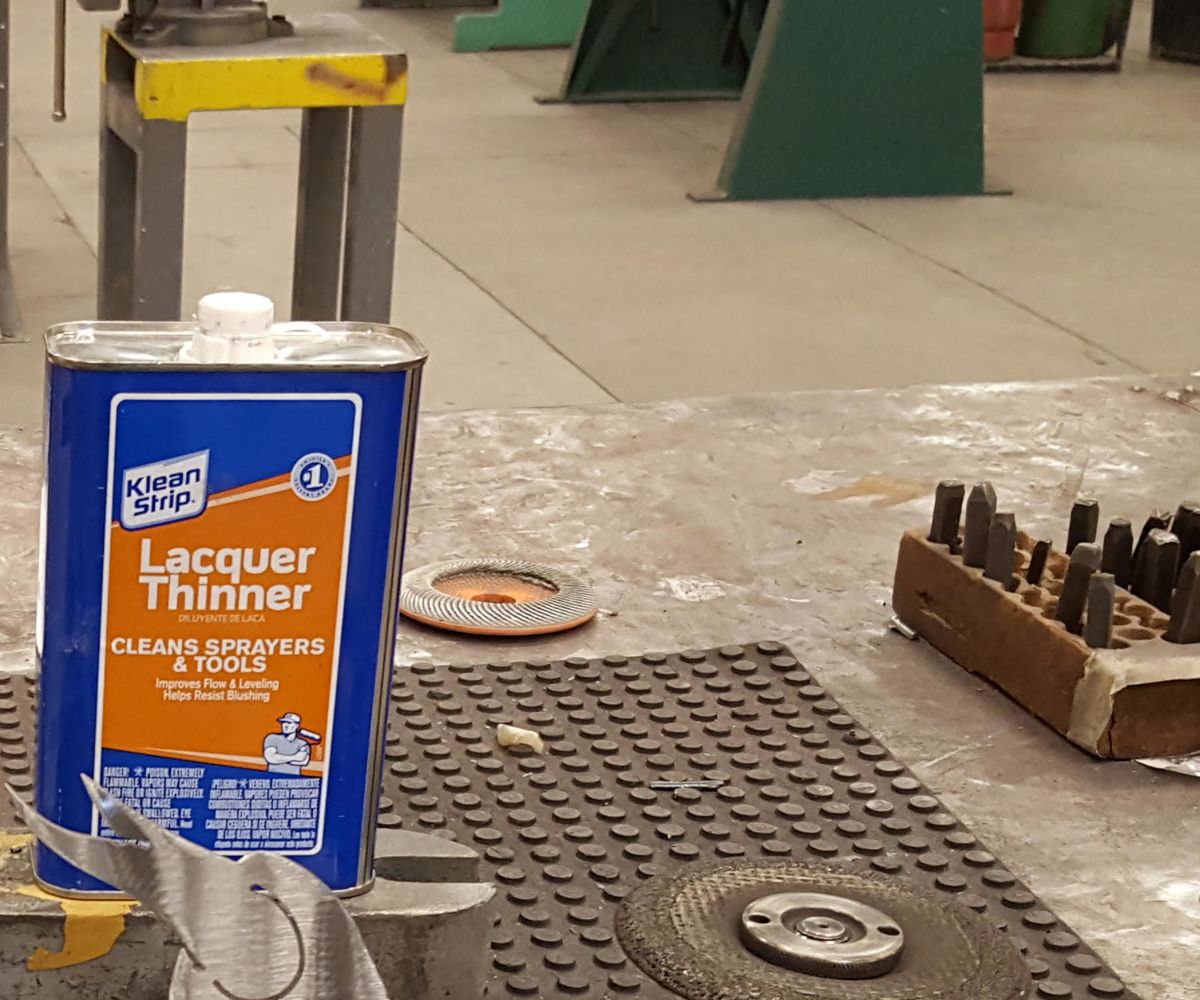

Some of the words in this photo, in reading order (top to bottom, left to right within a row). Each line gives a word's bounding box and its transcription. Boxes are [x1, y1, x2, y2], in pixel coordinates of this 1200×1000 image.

[126, 467, 201, 498] Klean
[140, 538, 317, 584] Lacquer
[138, 574, 312, 611] Thinner
[178, 614, 228, 623] DILUYENTE
[229, 614, 241, 623] DE
[242, 614, 266, 623] LACA
[111, 637, 199, 656] CLEANS
[204, 638, 325, 656] SPRAYERS
[173, 657, 188, 673] &
[194, 656, 267, 673] TOOLS
[155, 678, 201, 690] Improves
[203, 678, 226, 689] Flow
[229, 679, 236, 689] &
[239, 678, 280, 691] Leveling
[163, 690, 193, 703] Helps
[194, 690, 224, 701] Resist
[227, 690, 270, 703] Blushing
[179, 778, 199, 788] CAUSE
